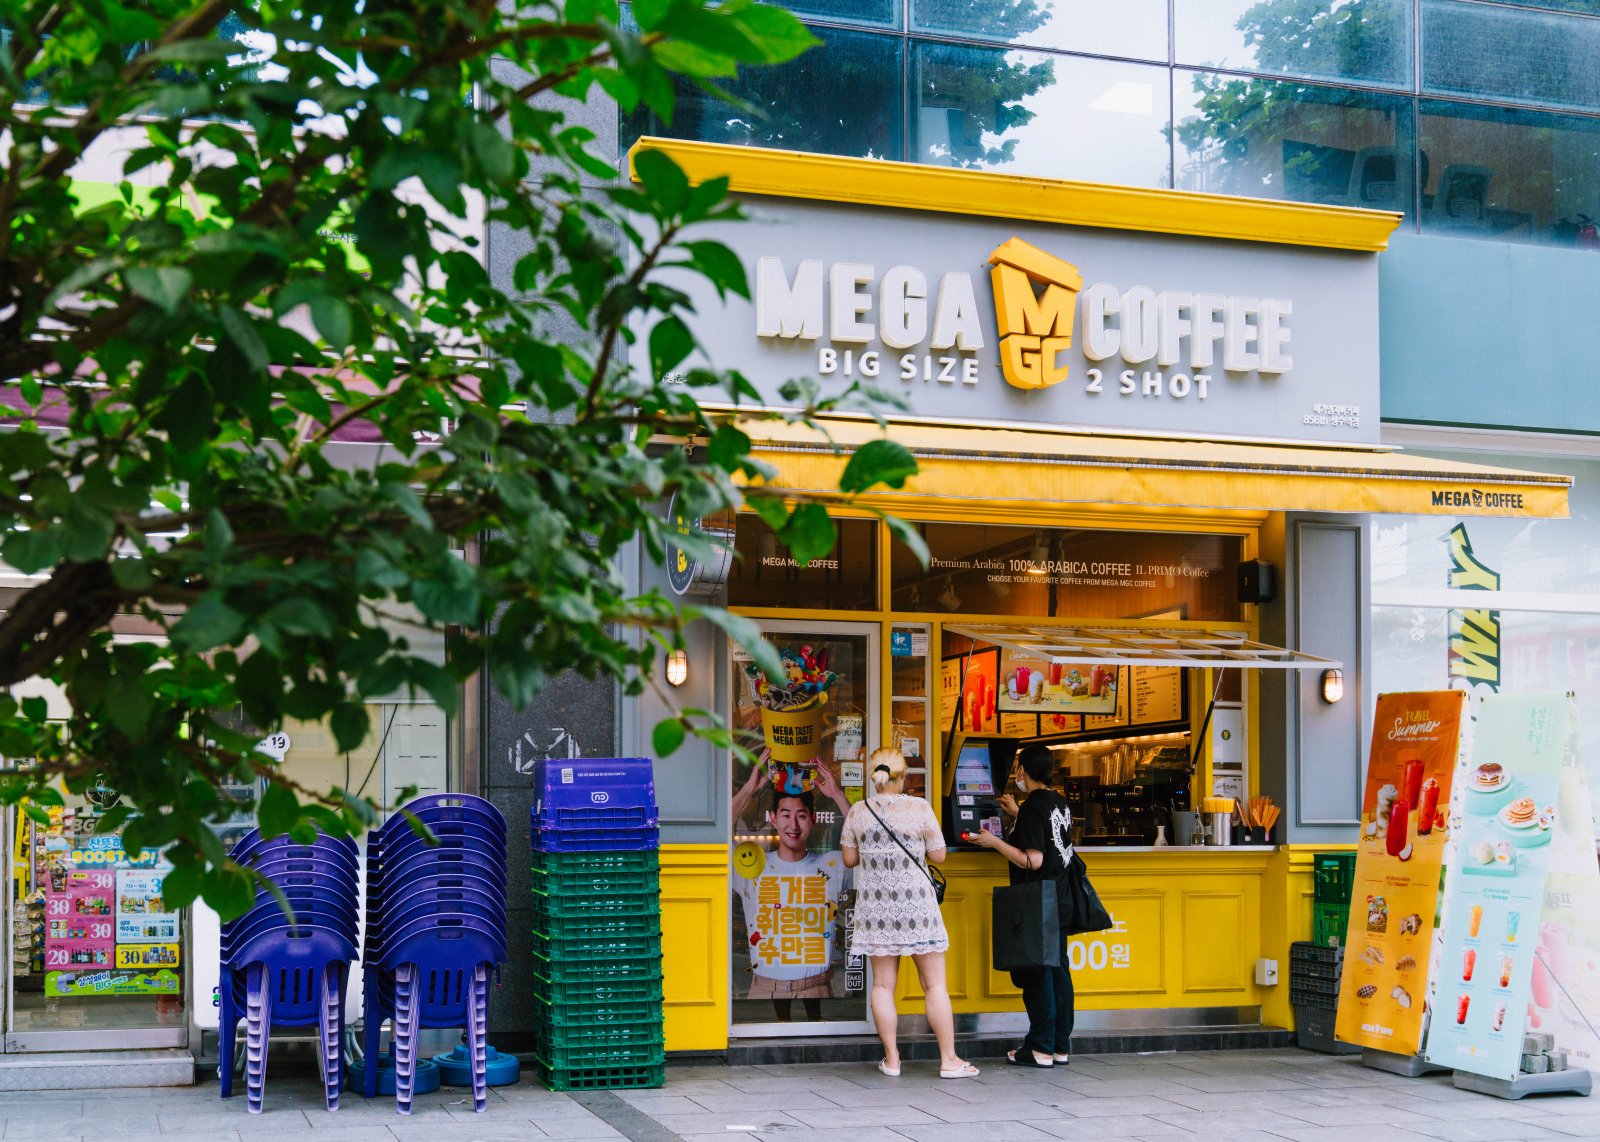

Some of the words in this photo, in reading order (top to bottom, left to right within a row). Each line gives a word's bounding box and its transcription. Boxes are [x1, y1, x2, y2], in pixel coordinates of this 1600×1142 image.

[756, 256, 984, 351] MEGA
[1081, 282, 1293, 374] COFFEE
[818, 347, 880, 376] BIG
[899, 354, 979, 384] SIZE
[1085, 368, 1103, 393] 2
[1119, 369, 1212, 399] SHOT
[1303, 414, 1329, 425] 856th
[1431, 490, 1471, 507] MEGA
[1485, 492, 1524, 509] COFFEE
[762, 557, 787, 567] MEGA
[807, 559, 839, 569] COFFEE
[931, 557, 971, 568] Premium
[972, 559, 1006, 570] Arabica
[1009, 559, 1037, 572] 100%
[1039, 560, 1089, 574] ARABICA
[1090, 562, 1132, 576] COFFEE
[1135, 564, 1147, 575] IL
[1148, 565, 1181, 577] PRIMO
[1182, 566, 1210, 578] Coffee
[987, 574, 1012, 583] CHOOSE
[1012, 575, 1029, 583] YOUR
[1030, 575, 1059, 585] FAVORITE
[1060, 577, 1082, 585] COFFEE
[1083, 578, 1100, 586] FROM
[1101, 578, 1119, 587] MEGA
[1119, 579, 1134, 587] MGC
[1134, 580, 1156, 588] COFFEE
[1406, 710, 1430, 722] TRAVEL
[772, 725, 794, 735] MEGA
[795, 725, 814, 735] TASTE
[1388, 717, 1441, 740] Summer
[773, 735, 794, 746] MEGA
[795, 734, 813, 745] SMILE
[816, 811, 835, 824] FFEE
[71, 850, 126, 864] BOOST
[92, 873, 113, 889] 30
[151, 878, 162, 894] 3
[758, 875, 826, 905] 즐거움
[48, 899, 70, 915] 30
[756, 904, 826, 935] 취향의
[90, 923, 112, 939] 30
[48, 949, 69, 965] 20
[120, 950, 140, 965] 30
[758, 936, 826, 965] 수만큼
[1066, 940, 1130, 971] 00원
[95, 979, 112, 992] BIG
